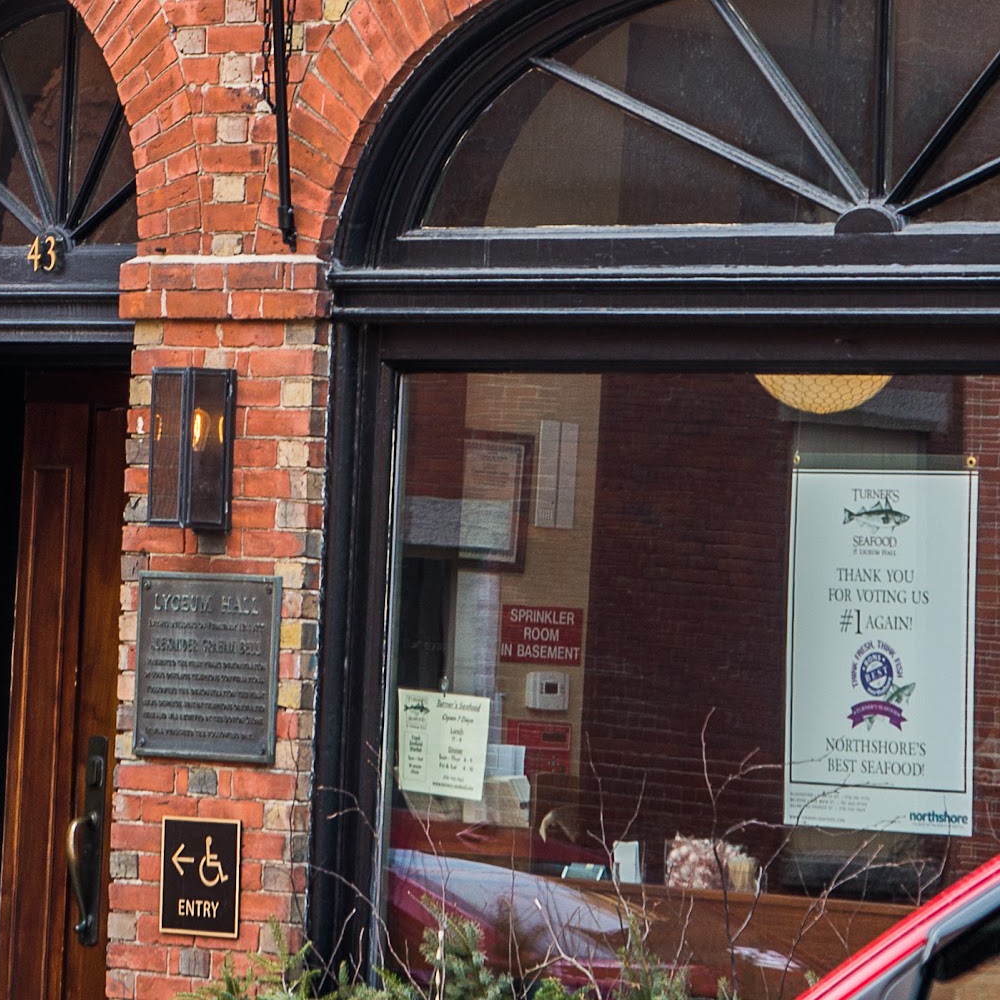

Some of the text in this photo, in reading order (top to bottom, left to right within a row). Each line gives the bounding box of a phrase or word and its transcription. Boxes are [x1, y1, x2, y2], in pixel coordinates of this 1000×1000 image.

[27, 235, 57, 272] 43
[852, 488, 900, 503] TURNER'S
[853, 535, 898, 548] SEAFOOD
[836, 567, 915, 583] THANK YOU
[153, 593, 259, 614] LYCEUM HALL
[828, 588, 930, 605] FOR VOTING US
[510, 608, 575, 625] SPRINKLER
[839, 608, 913, 635] #1 AGAIN!
[523, 626, 560, 642] ROOM
[500, 643, 580, 660] IN BASEMENT
[442, 713, 457, 723] Open
[461, 716, 474, 726] Days
[825, 737, 927, 756] NORTHSHORE'S
[828, 758, 925, 776] BEST SEAFOOD!
[909, 810, 968, 824] northshore
[178, 898, 220, 918] ENTRY
